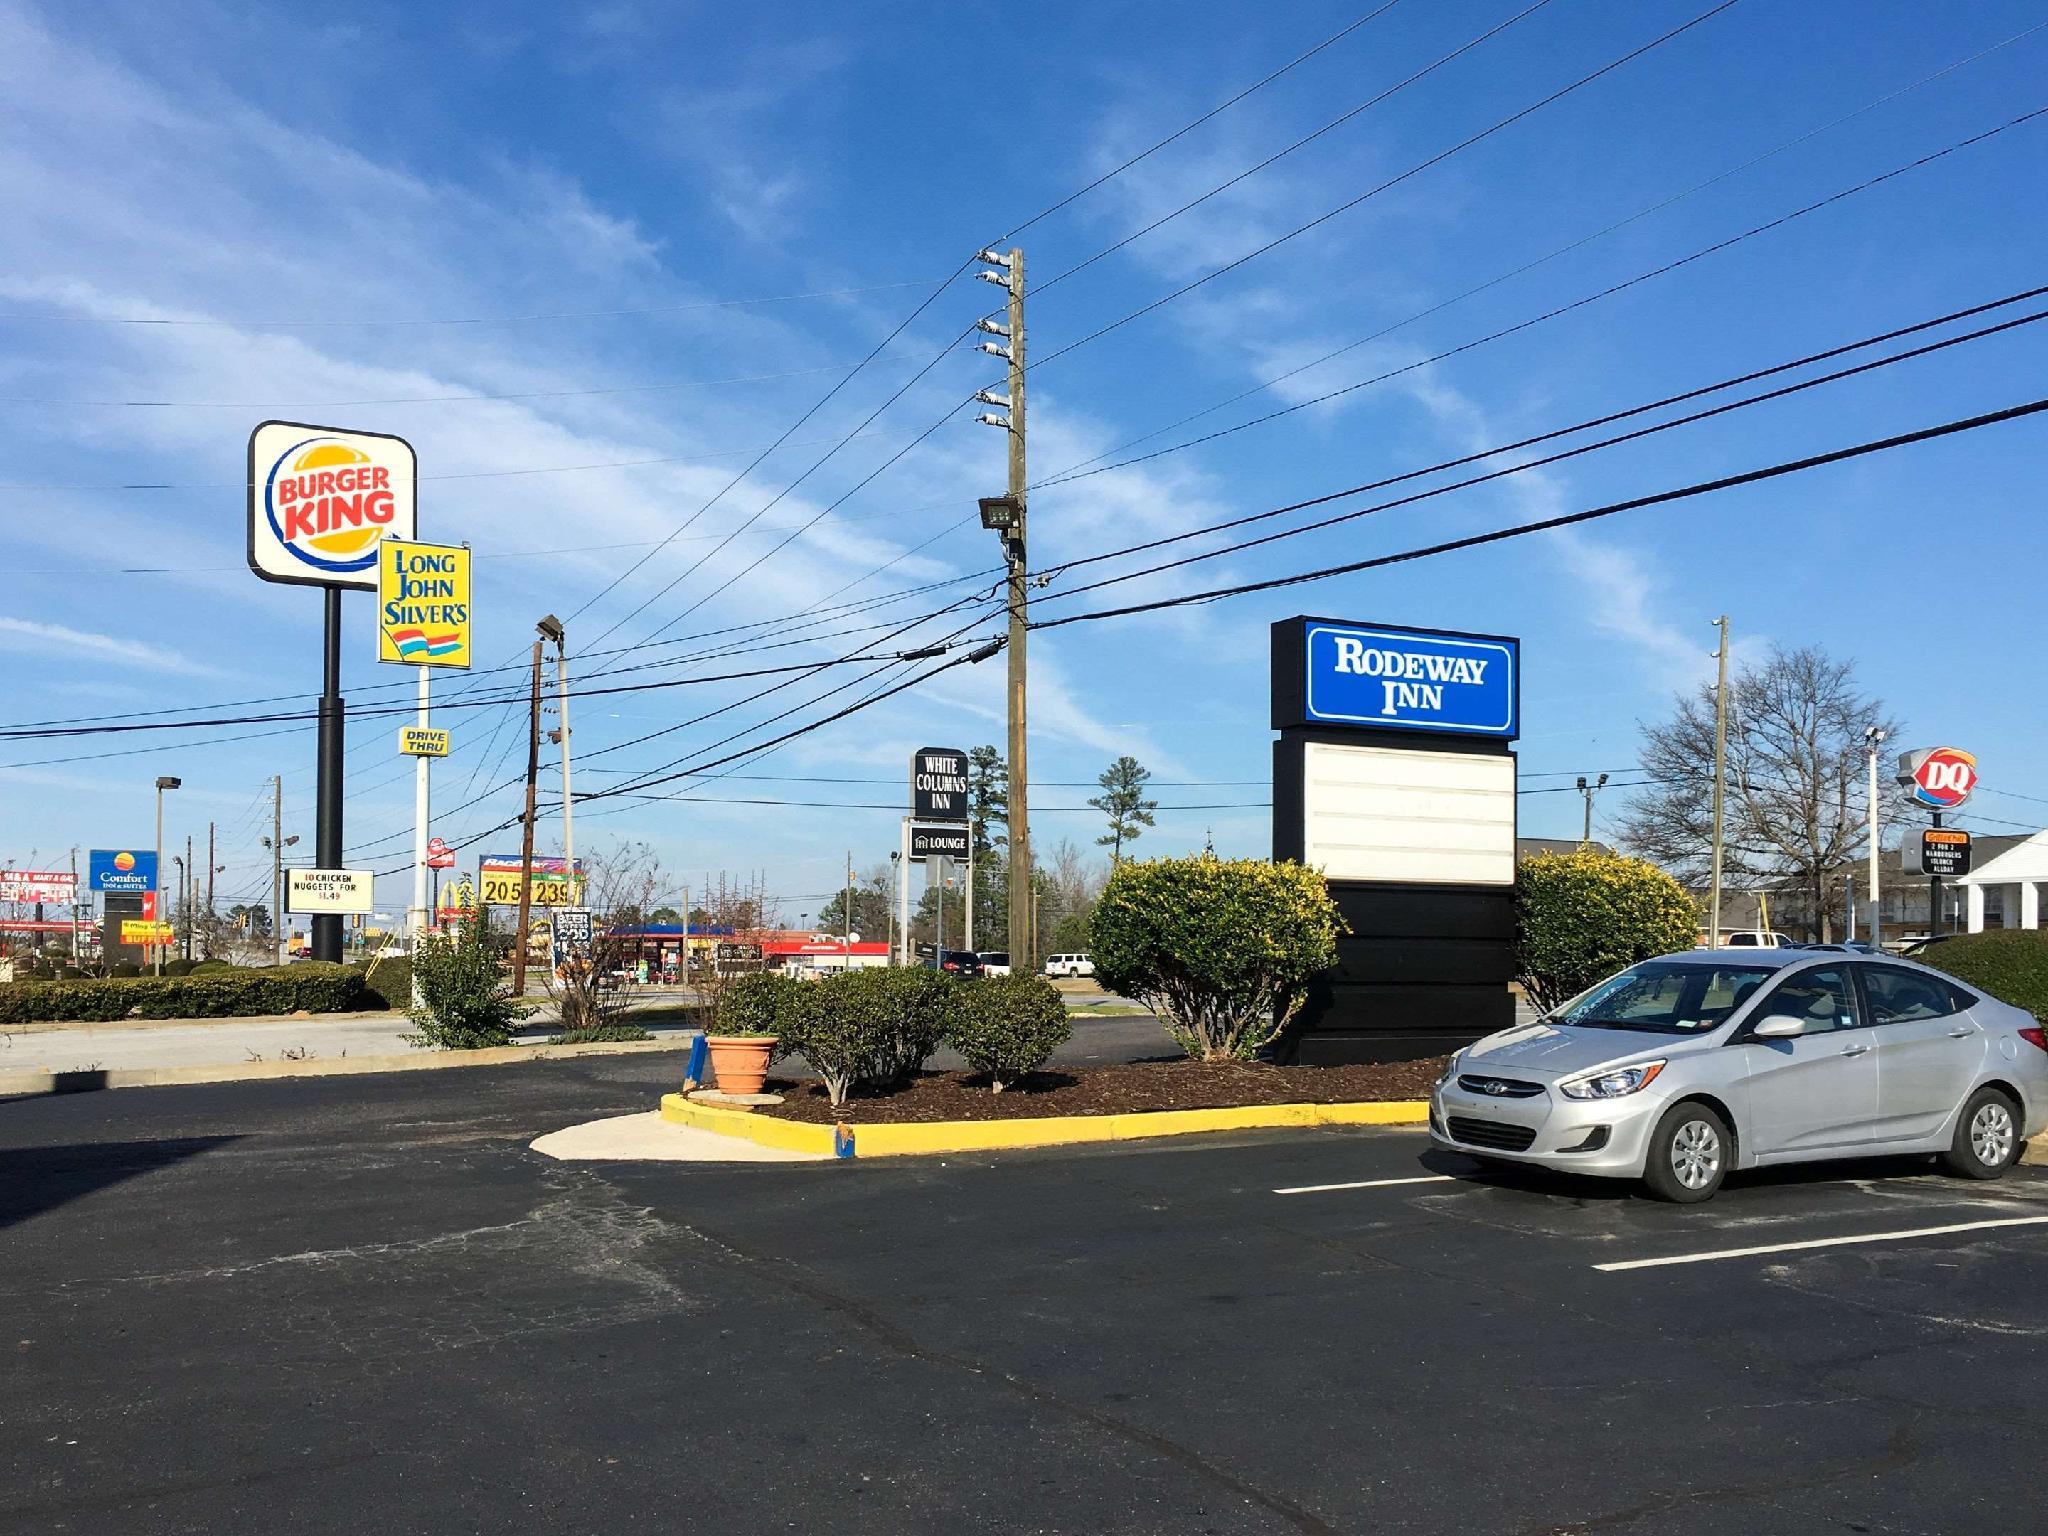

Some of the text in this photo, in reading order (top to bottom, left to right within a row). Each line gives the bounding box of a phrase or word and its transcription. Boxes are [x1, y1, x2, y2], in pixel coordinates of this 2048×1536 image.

[279, 467, 389, 506] BURGER
[285, 491, 394, 541] KING
[395, 550, 455, 574] LONG
[394, 574, 454, 601] JOHN
[385, 601, 467, 625] SILVER'S
[1334, 637, 1488, 686] RODEWAY
[1381, 681, 1443, 716] INN
[406, 731, 445, 741] DRIVE
[409, 742, 444, 752] THRU
[925, 757, 958, 774] WHITE
[917, 774, 966, 793] COLUMNS
[1925, 761, 1969, 795] DQ
[932, 794, 950, 809] INN
[930, 838, 965, 849] LOUNGE
[1925, 850, 1962, 858] HAMBURGERS
[100, 872, 148, 883] Comfort
[305, 873, 352, 882] 10 CHICKEN
[294, 882, 334, 890] NUGGETS
[319, 892, 341, 900] $1.49
[557, 913, 588, 924] BEER
